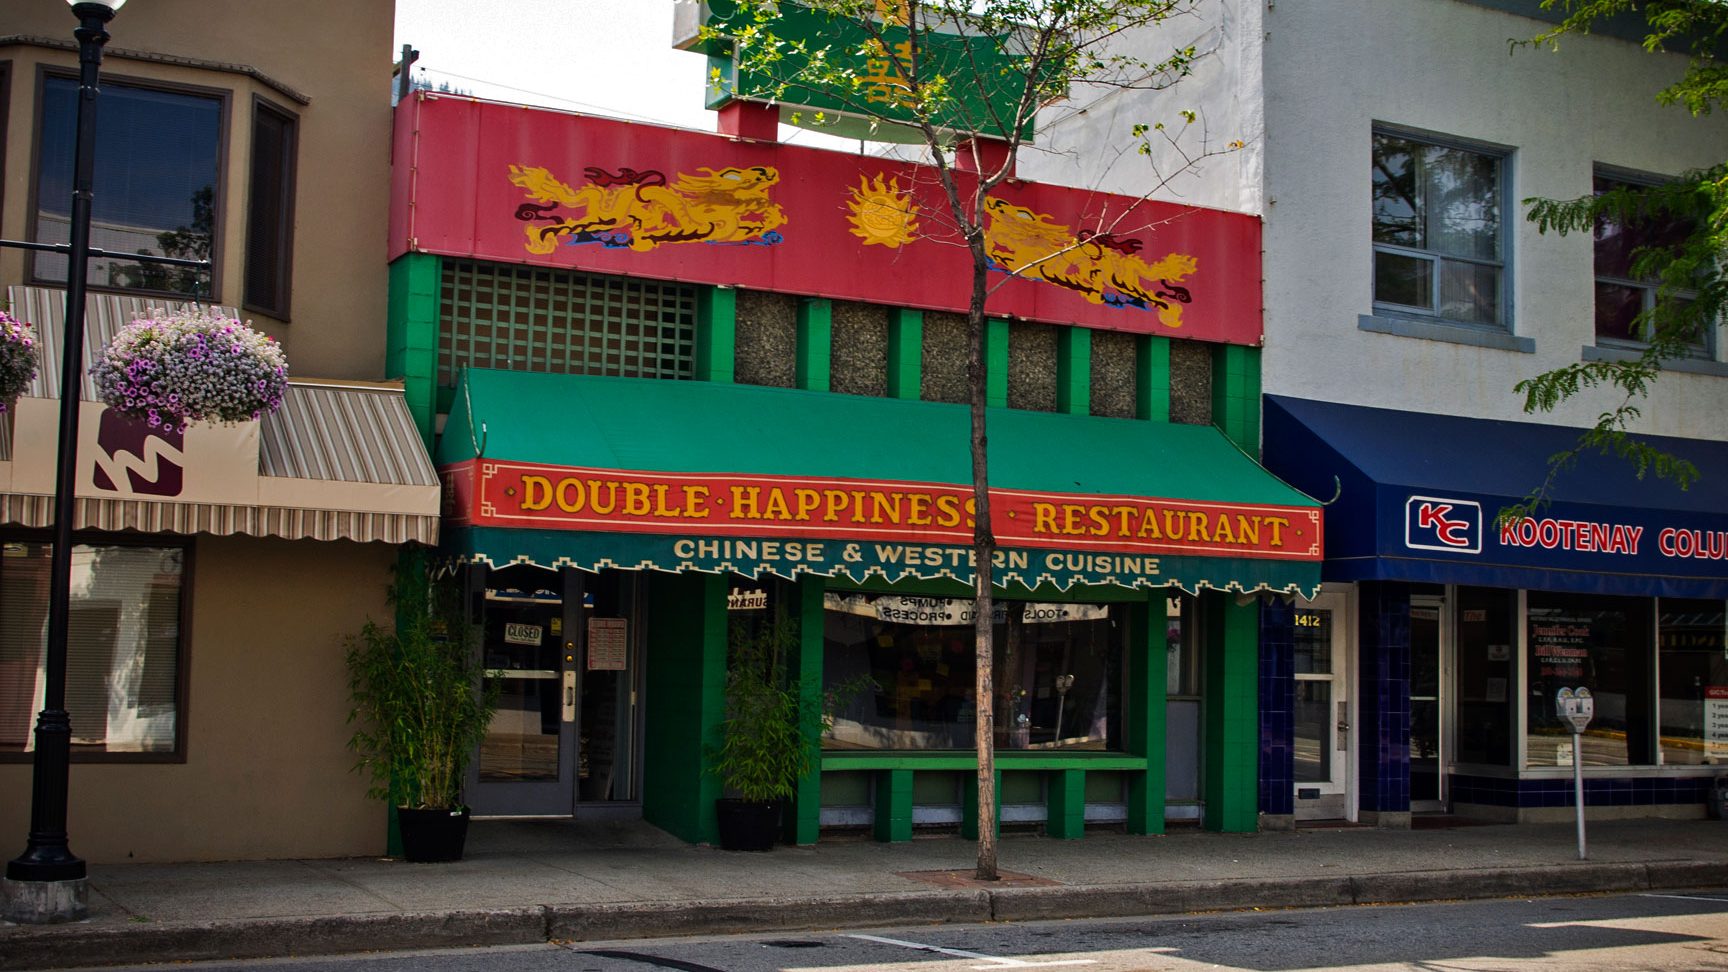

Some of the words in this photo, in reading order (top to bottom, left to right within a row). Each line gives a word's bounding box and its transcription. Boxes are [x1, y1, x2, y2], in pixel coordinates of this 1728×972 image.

[520, 475, 710, 518] DOUBLE
[1033, 502, 1290, 546] RESTAURANT
[1501, 515, 1643, 555] KOOTENAY
[1658, 527, 1728, 560] COLU
[674, 539, 825, 562] CHINESE
[842, 543, 861, 562] &
[1045, 552, 1161, 576] CUISINE
[508, 624, 540, 639] CLOSED
[1294, 614, 1320, 627] 1412
